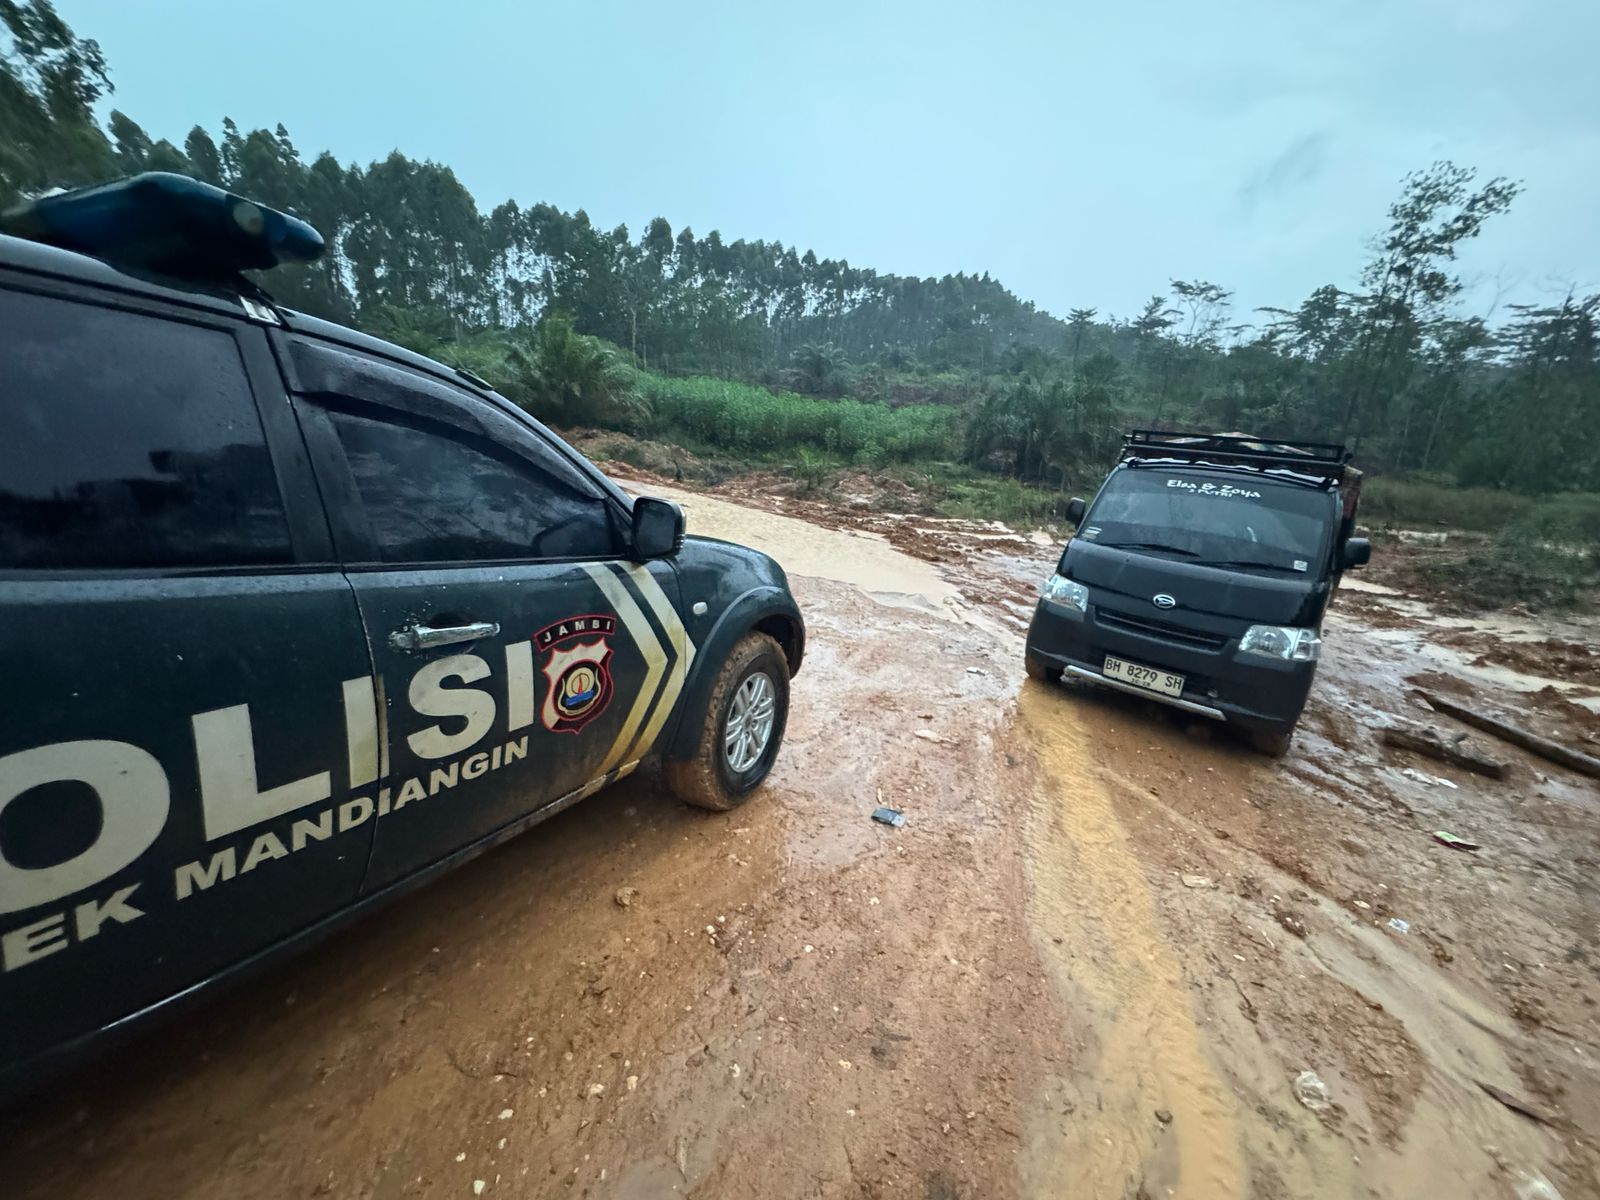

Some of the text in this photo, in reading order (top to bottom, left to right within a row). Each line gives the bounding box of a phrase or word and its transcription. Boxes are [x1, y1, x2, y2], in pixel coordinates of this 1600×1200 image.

[1201, 482, 1217, 491] &
[1220, 484, 1262, 498] Zoya
[543, 619, 612, 643] JAMBI
[1105, 658, 1121, 673] BH
[1127, 665, 1158, 683] 8279
[1165, 675, 1183, 690] SH
[1, 736, 530, 973] EK MANDIANGIN
